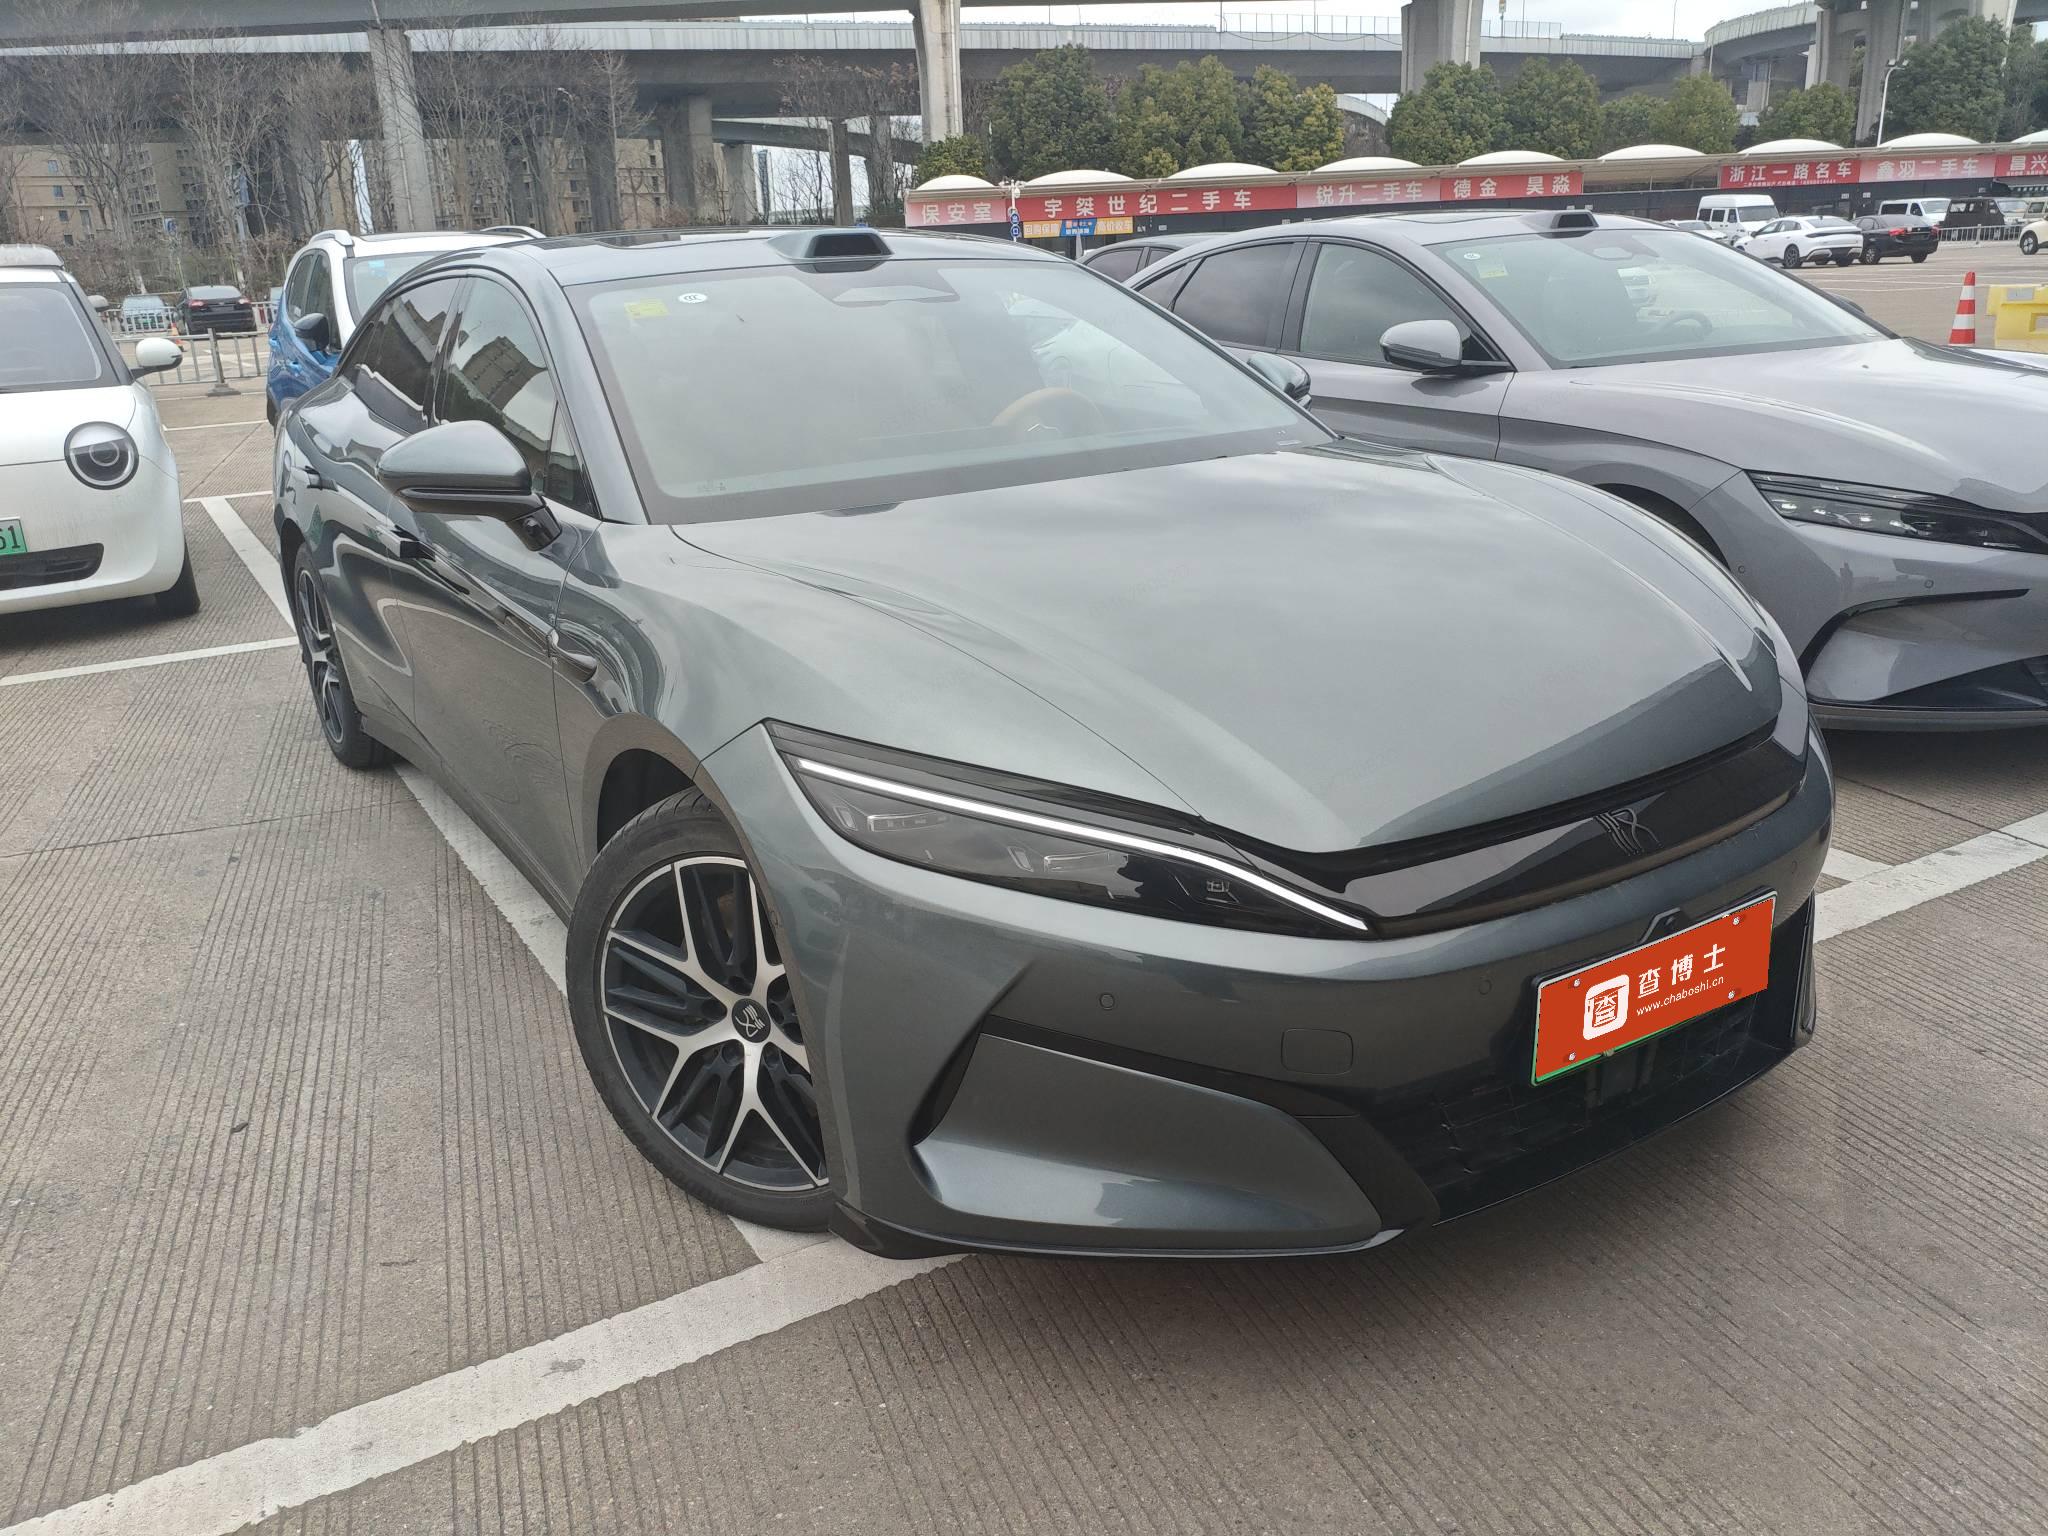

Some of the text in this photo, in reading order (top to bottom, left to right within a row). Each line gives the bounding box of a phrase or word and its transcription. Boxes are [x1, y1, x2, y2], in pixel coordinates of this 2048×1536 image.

[1729, 161, 1852, 182] 浙江一路名车
[1876, 158, 1979, 180] 鑫羽二手车
[1316, 181, 1423, 205] 锐升二手车
[921, 202, 992, 224] 保安室
